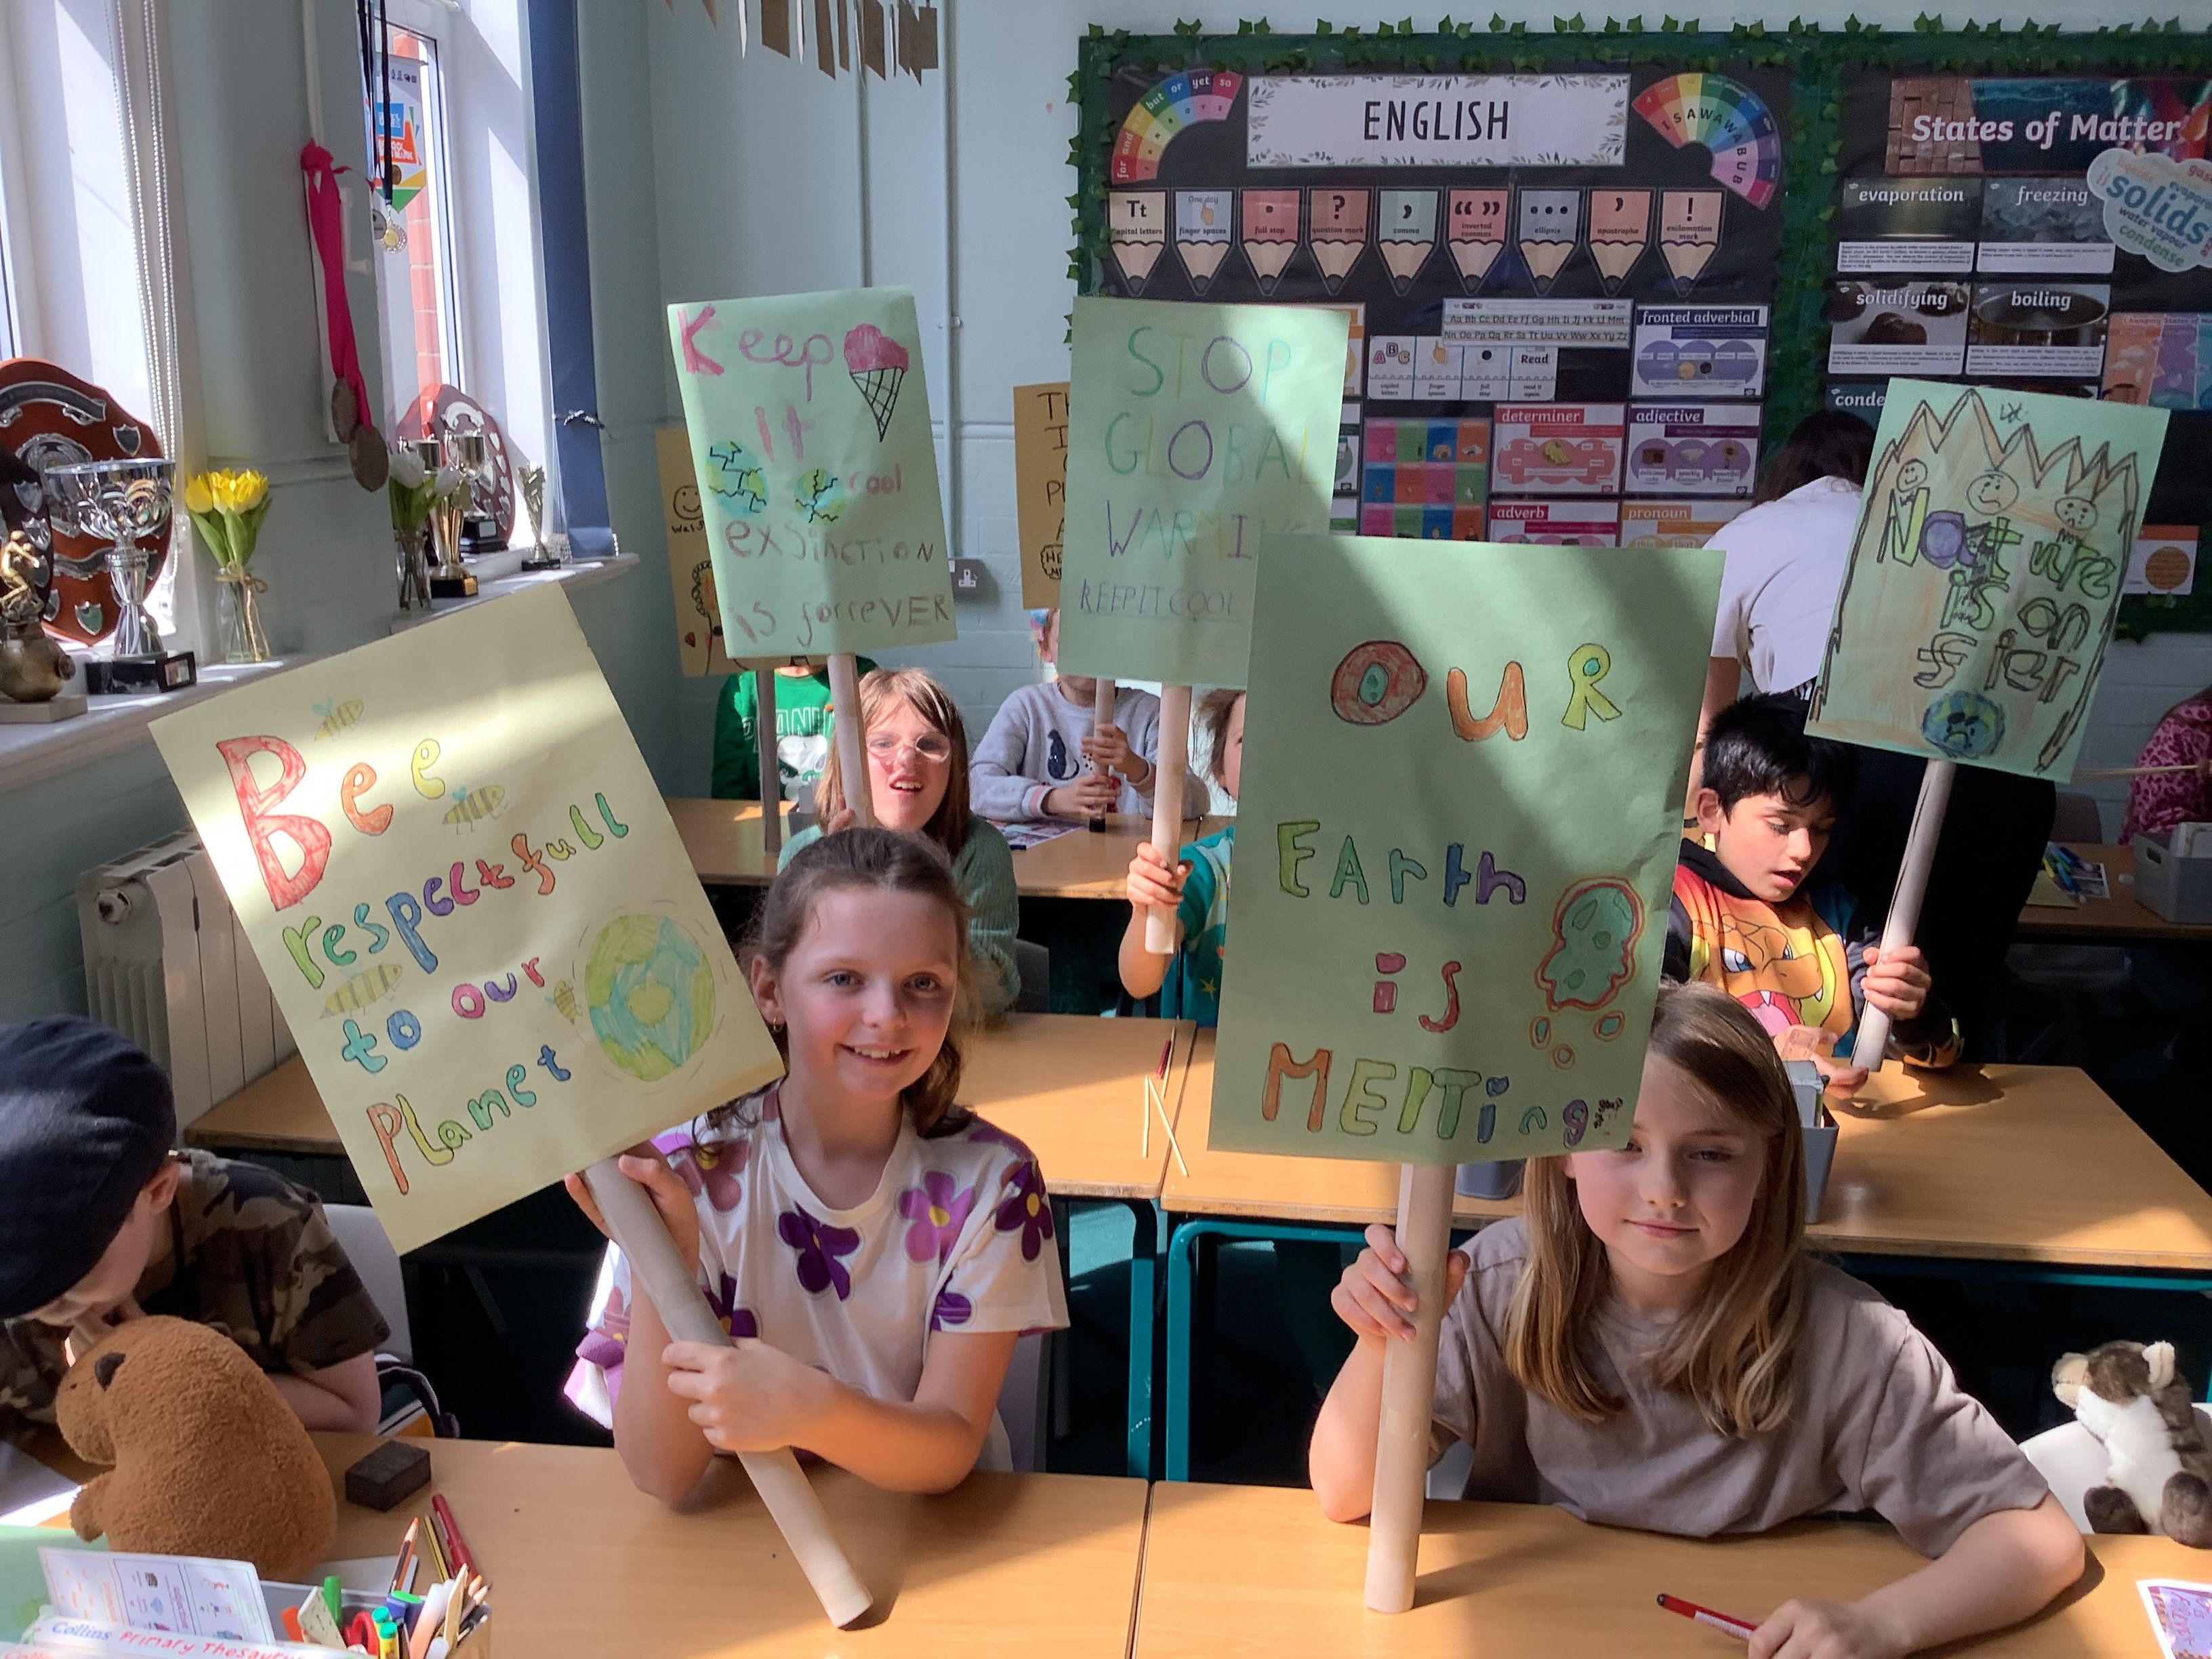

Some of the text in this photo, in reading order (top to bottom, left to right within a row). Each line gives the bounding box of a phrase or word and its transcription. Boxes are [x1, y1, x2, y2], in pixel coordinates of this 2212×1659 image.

[1171, 83, 1183, 94] or
[1192, 75, 1210, 89] yet
[1219, 77, 1231, 87] so
[1145, 92, 1164, 110] but
[1364, 100, 1509, 142] ENGLISH
[1911, 110, 2182, 150] States of Matter
[1118, 161, 1129, 179] for
[1188, 195, 1218, 206] One day
[1859, 186, 1964, 205] evaporation
[2016, 186, 2088, 206] freezing
[1126, 200, 1147, 218] Tt
[2106, 176, 2209, 244] solids
[1140, 226, 1163, 236] letters
[1179, 226, 1201, 236] finger
[1254, 226, 1286, 236] full stop
[1534, 226, 1561, 235] ellipsis
[1597, 227, 1639, 237] apostrophe
[2119, 207, 2149, 228] water
[2151, 224, 2188, 249] vapour
[2119, 224, 2184, 266] condense
[1856, 289, 1948, 310] solidifying
[2011, 291, 2072, 311] boiling
[1643, 310, 1755, 325] fronted adverbial
[677, 304, 835, 403] Keep
[1521, 353, 1549, 365] Read
[1128, 325, 1293, 405] STOP
[1502, 409, 1580, 423] determiner
[1636, 409, 1701, 424] adjective
[1104, 411, 1320, 485] GLOBAL
[1497, 506, 1545, 519] adverb
[1629, 509, 1687, 520] pronoun
[2017, 596, 2091, 651] on
[215, 734, 447, 913] Bee
[282, 790, 630, 990] respectfull
[341, 954, 548, 1075] to our
[51, 1620, 112, 1642] Collins
[119, 1629, 197, 1658] Primary
